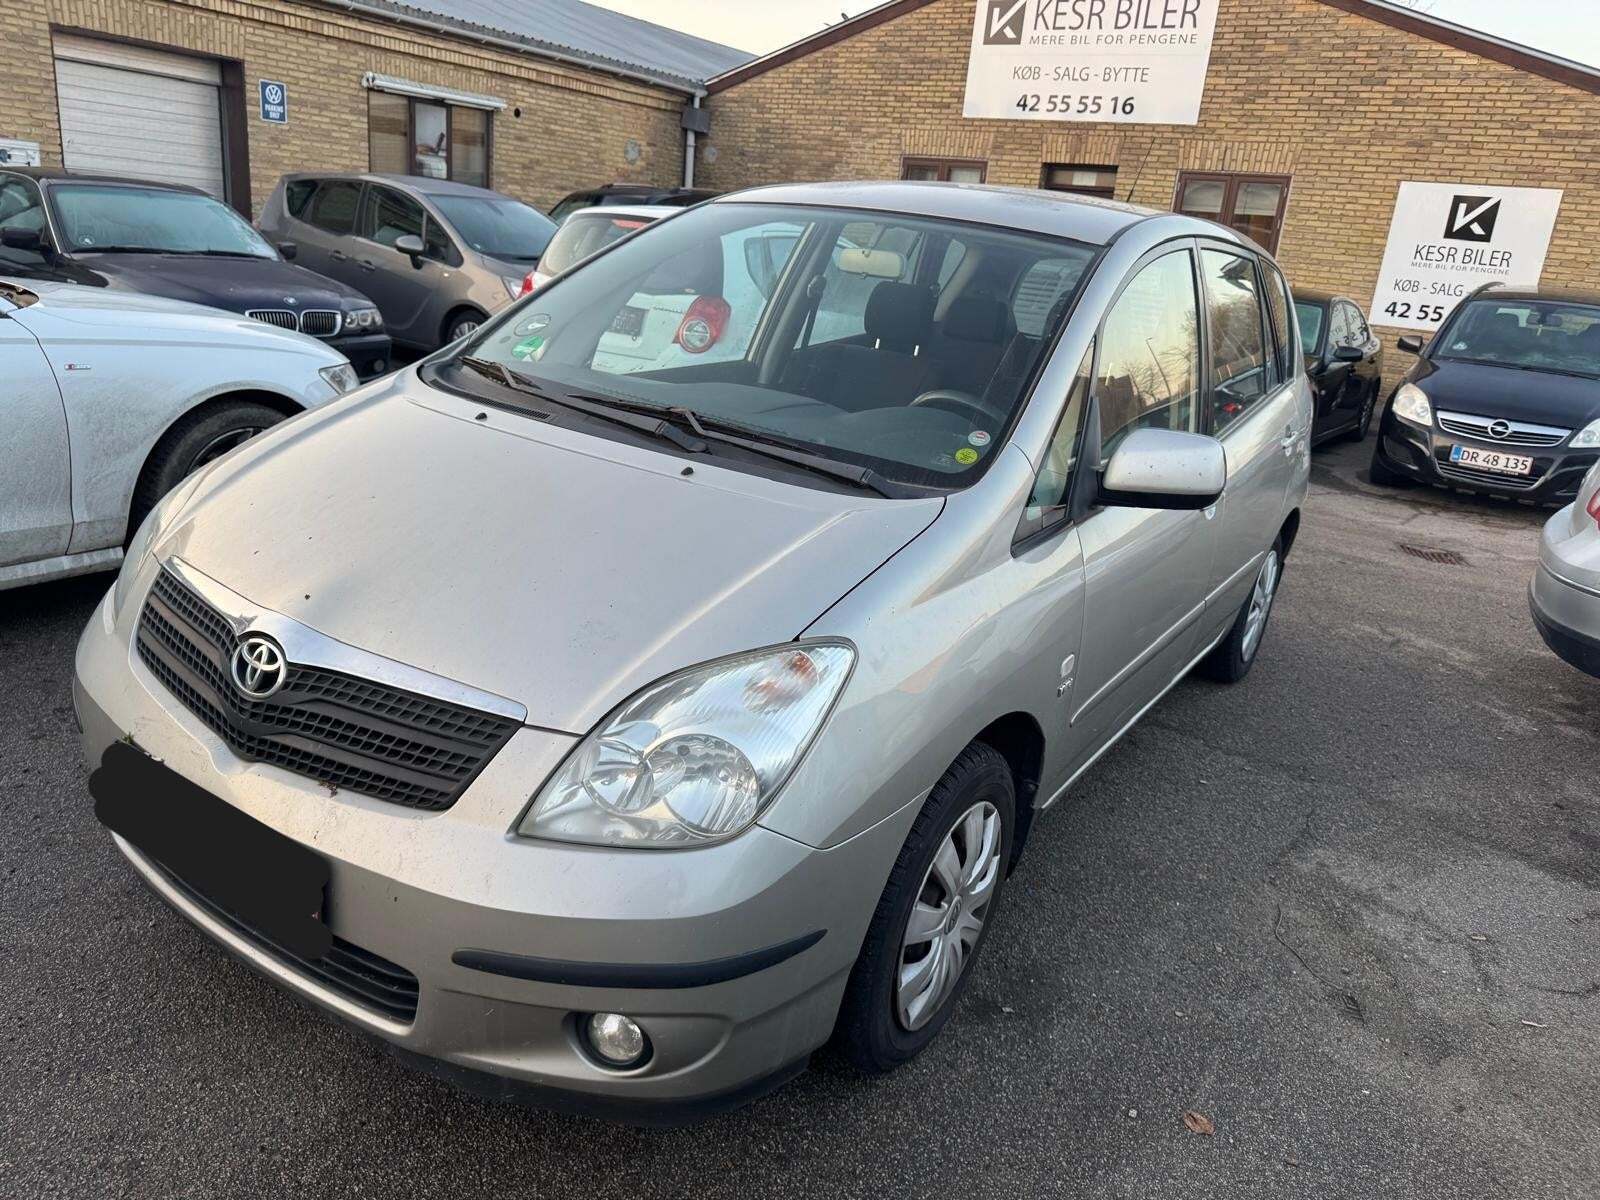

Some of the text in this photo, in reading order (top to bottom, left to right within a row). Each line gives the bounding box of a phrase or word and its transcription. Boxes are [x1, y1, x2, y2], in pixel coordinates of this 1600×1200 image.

[1033, 0, 1201, 31] KESR BILER
[1029, 33, 1199, 45] MERE BIL FOR PENGENE
[1012, 66, 1041, 81] KØB
[1053, 66, 1091, 82] SALG
[1102, 67, 1150, 83] BYTTE
[1016, 94, 1135, 115] 42 55 55 16
[1413, 244, 1513, 268] KESR BILER
[1411, 261, 1433, 269] MERE
[1470, 267, 1511, 276] PENGENE
[1393, 278, 1420, 293] KØB
[1430, 281, 1464, 297] SALG
[1384, 301, 1445, 322] 42 55
[1461, 450, 1479, 463] DR
[1482, 454, 1500, 467] 48
[1503, 457, 1529, 471] 135
